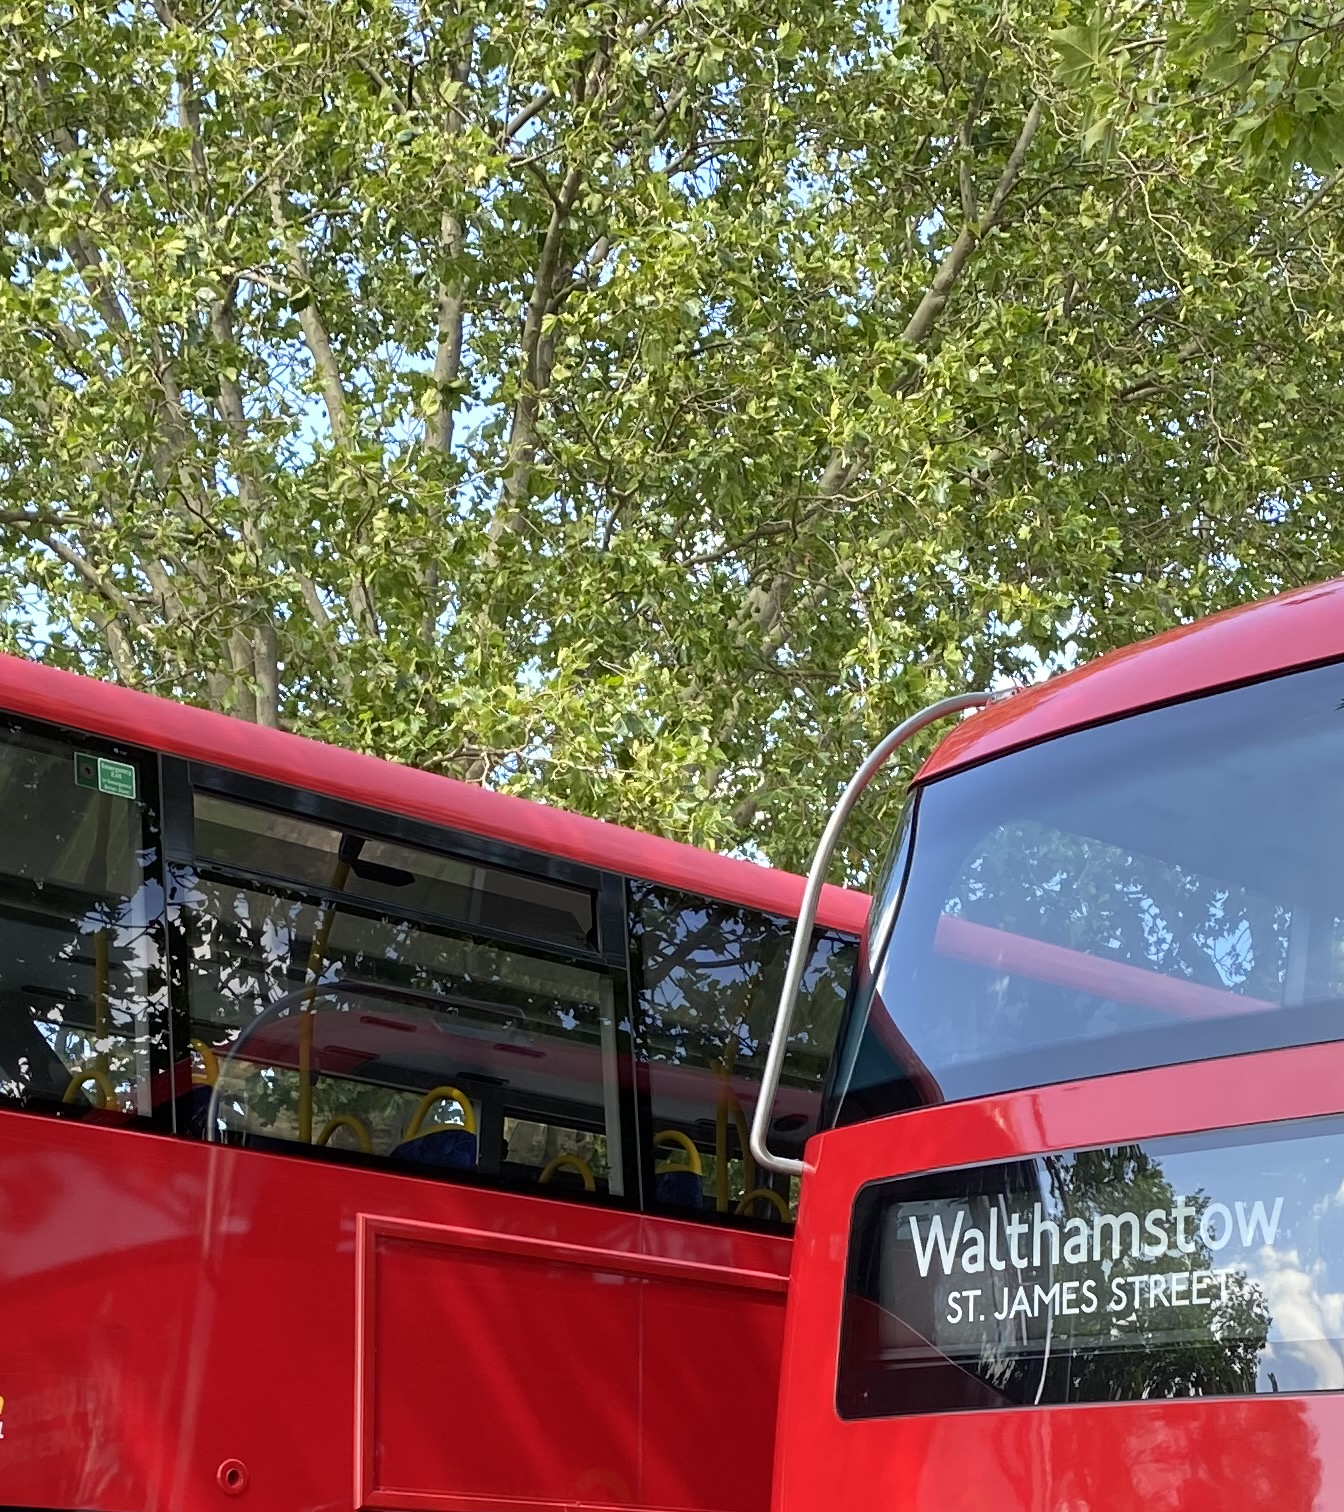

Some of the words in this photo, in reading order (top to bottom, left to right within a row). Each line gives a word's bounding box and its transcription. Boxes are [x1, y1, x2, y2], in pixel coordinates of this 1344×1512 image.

[909, 1195, 1284, 1278] Walthamstow
[946, 1289, 985, 1324] ST.
[993, 1280, 1098, 1321] JAMES
[1110, 1267, 1238, 1311] STREET
